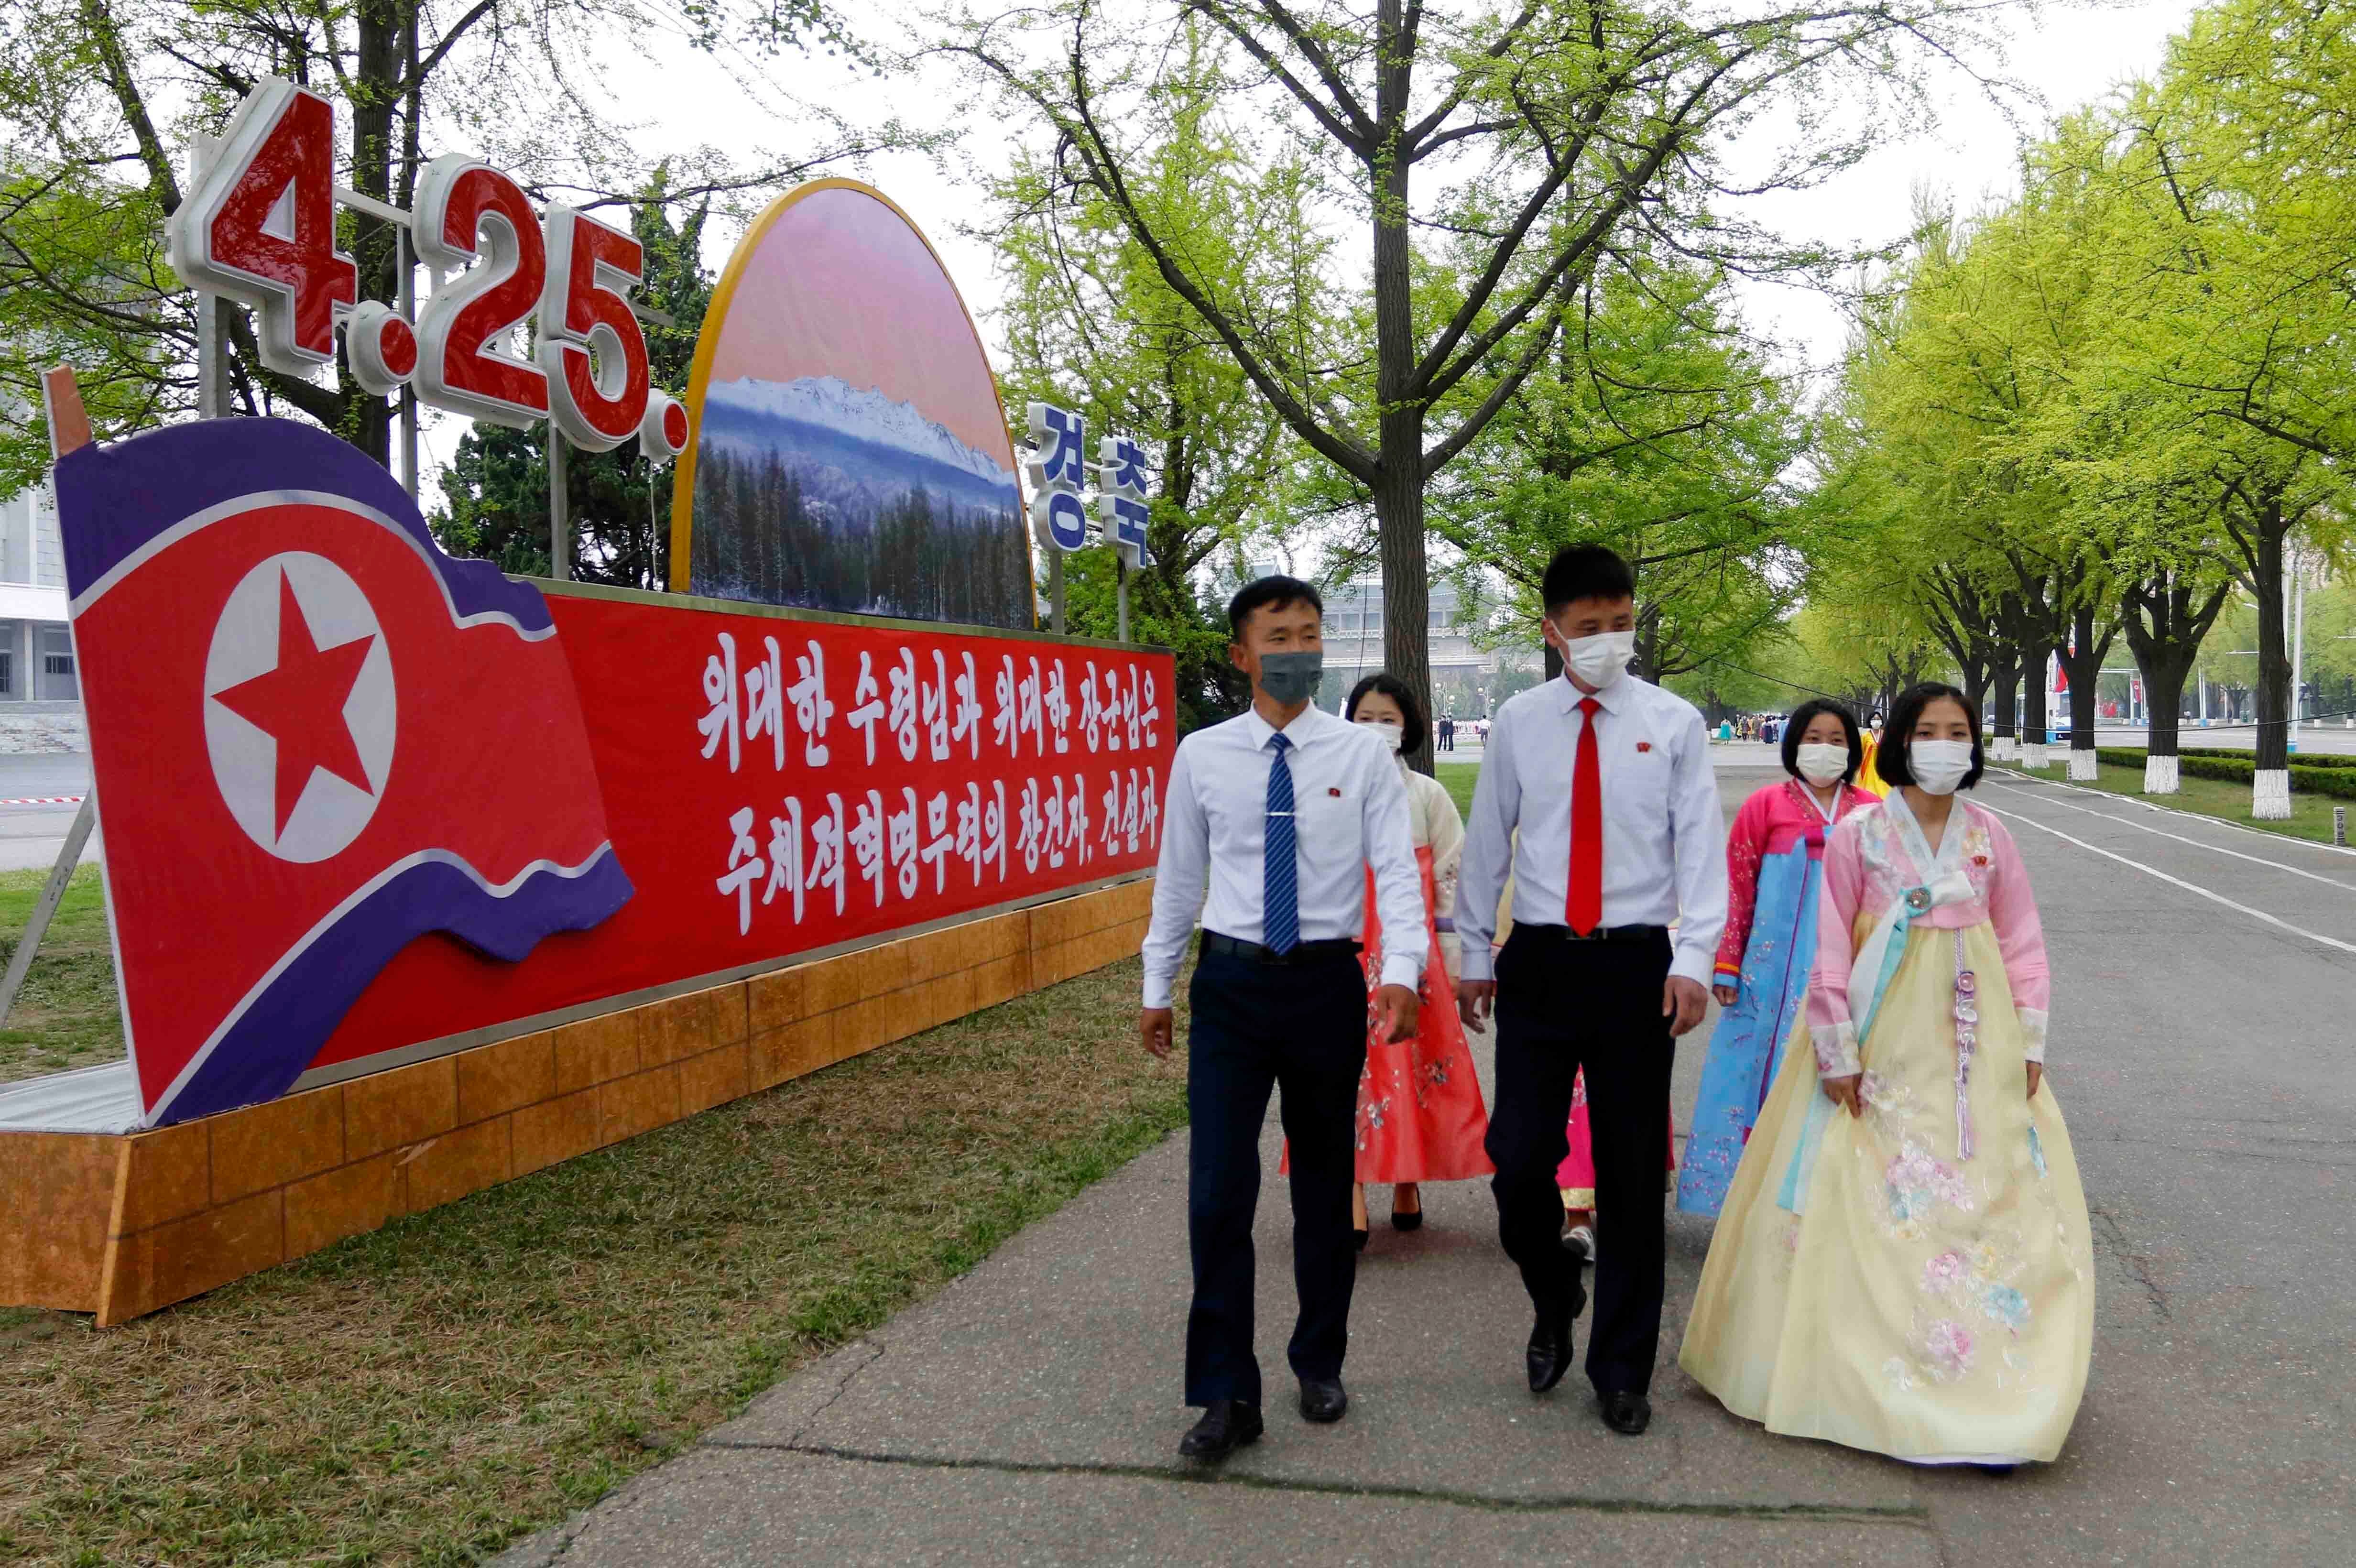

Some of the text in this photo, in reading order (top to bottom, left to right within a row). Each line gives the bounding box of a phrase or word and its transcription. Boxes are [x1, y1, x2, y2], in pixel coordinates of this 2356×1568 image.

[167, 76, 688, 463] 4.25.
[1028, 402, 1151, 569] 경축
[698, 632, 1158, 773] 위대한 수령님과 위대한 장군님은
[1015, 773, 1092, 874] 창건자,
[1100, 766, 1158, 856] 건설자
